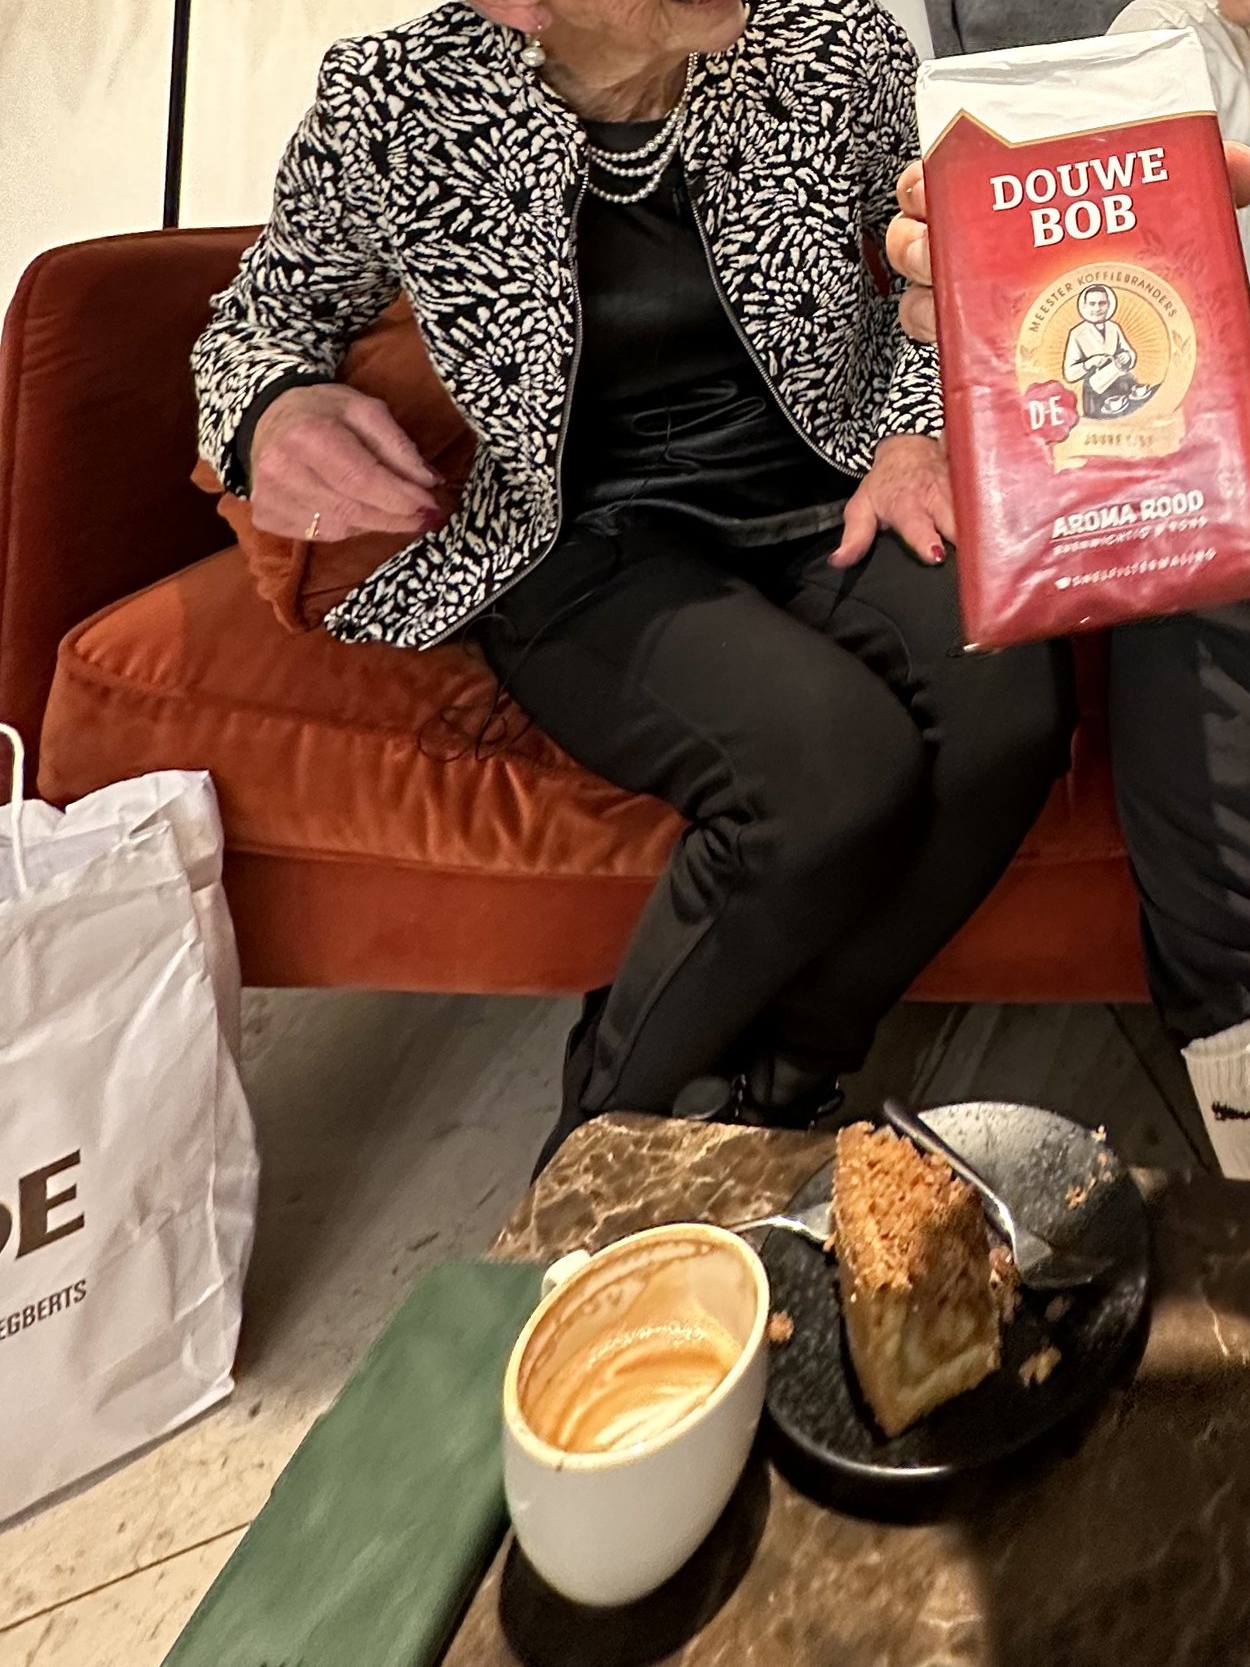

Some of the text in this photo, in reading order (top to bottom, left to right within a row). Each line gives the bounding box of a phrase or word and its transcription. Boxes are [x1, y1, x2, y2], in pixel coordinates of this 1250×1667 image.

[989, 147, 1169, 211] DOUWE
[1030, 194, 1137, 248] BOB
[1029, 271, 1179, 333] MEESTER KOFFIEBRANDERS
[1051, 489, 1204, 539] AROMA ROOD
